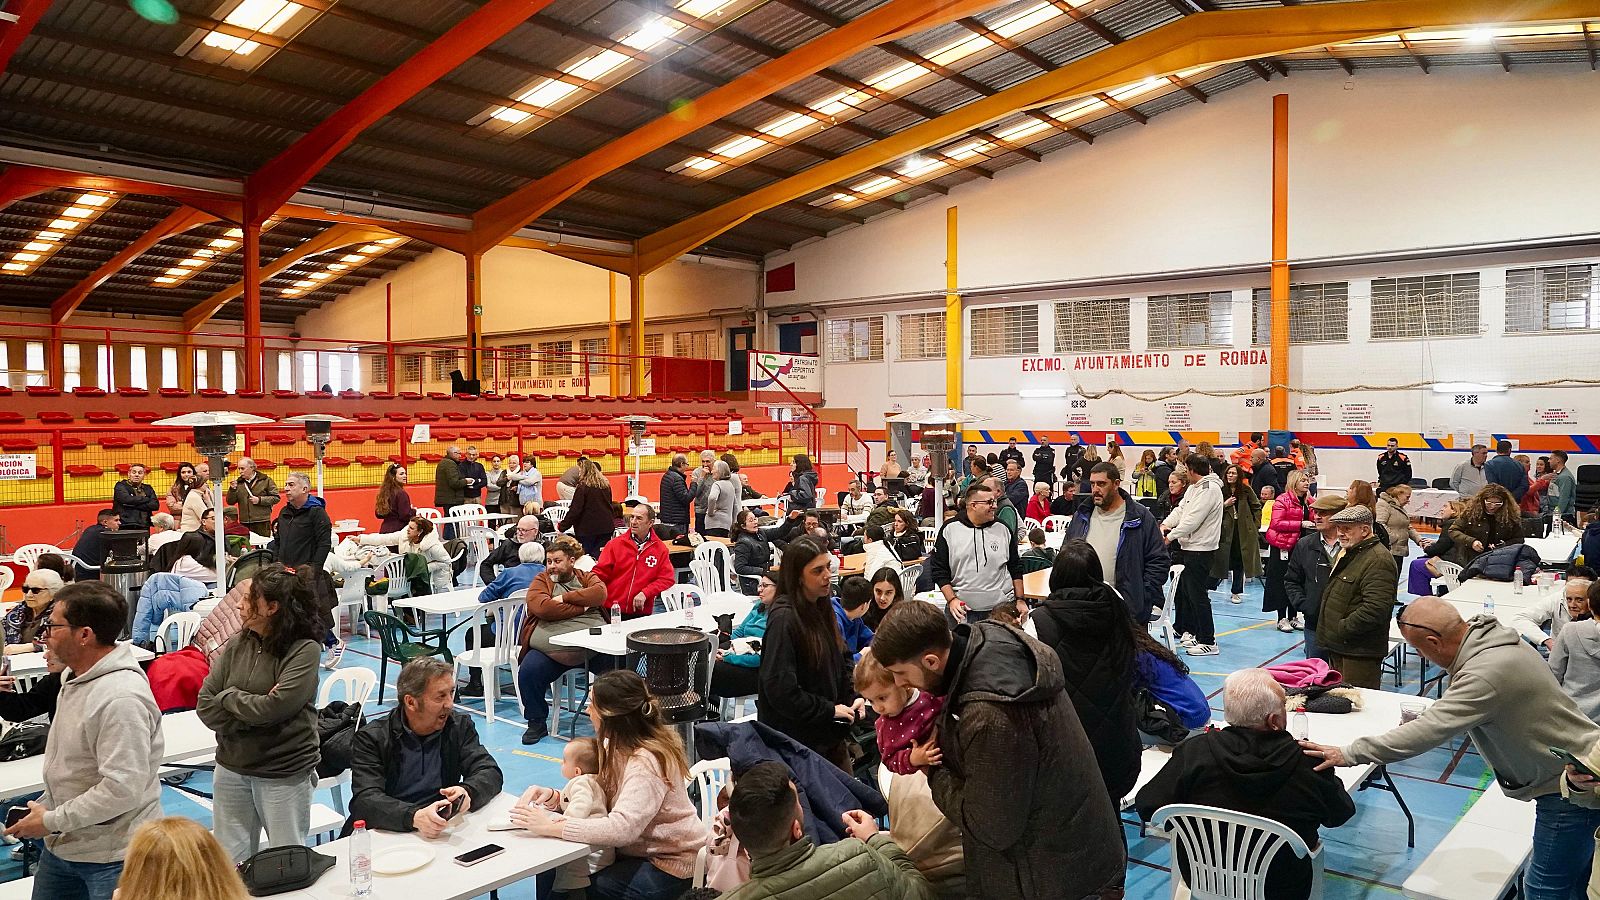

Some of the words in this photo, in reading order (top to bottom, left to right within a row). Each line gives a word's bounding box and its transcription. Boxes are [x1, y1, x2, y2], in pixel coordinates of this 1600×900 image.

[1022, 358, 1065, 371] EXCMO.
[1074, 353, 1170, 371] AYUNTAMIENTO
[1184, 354, 1206, 367] DE
[1220, 350, 1268, 366] RONDA
[512, 379, 553, 390] AYUNTAMIENTO
